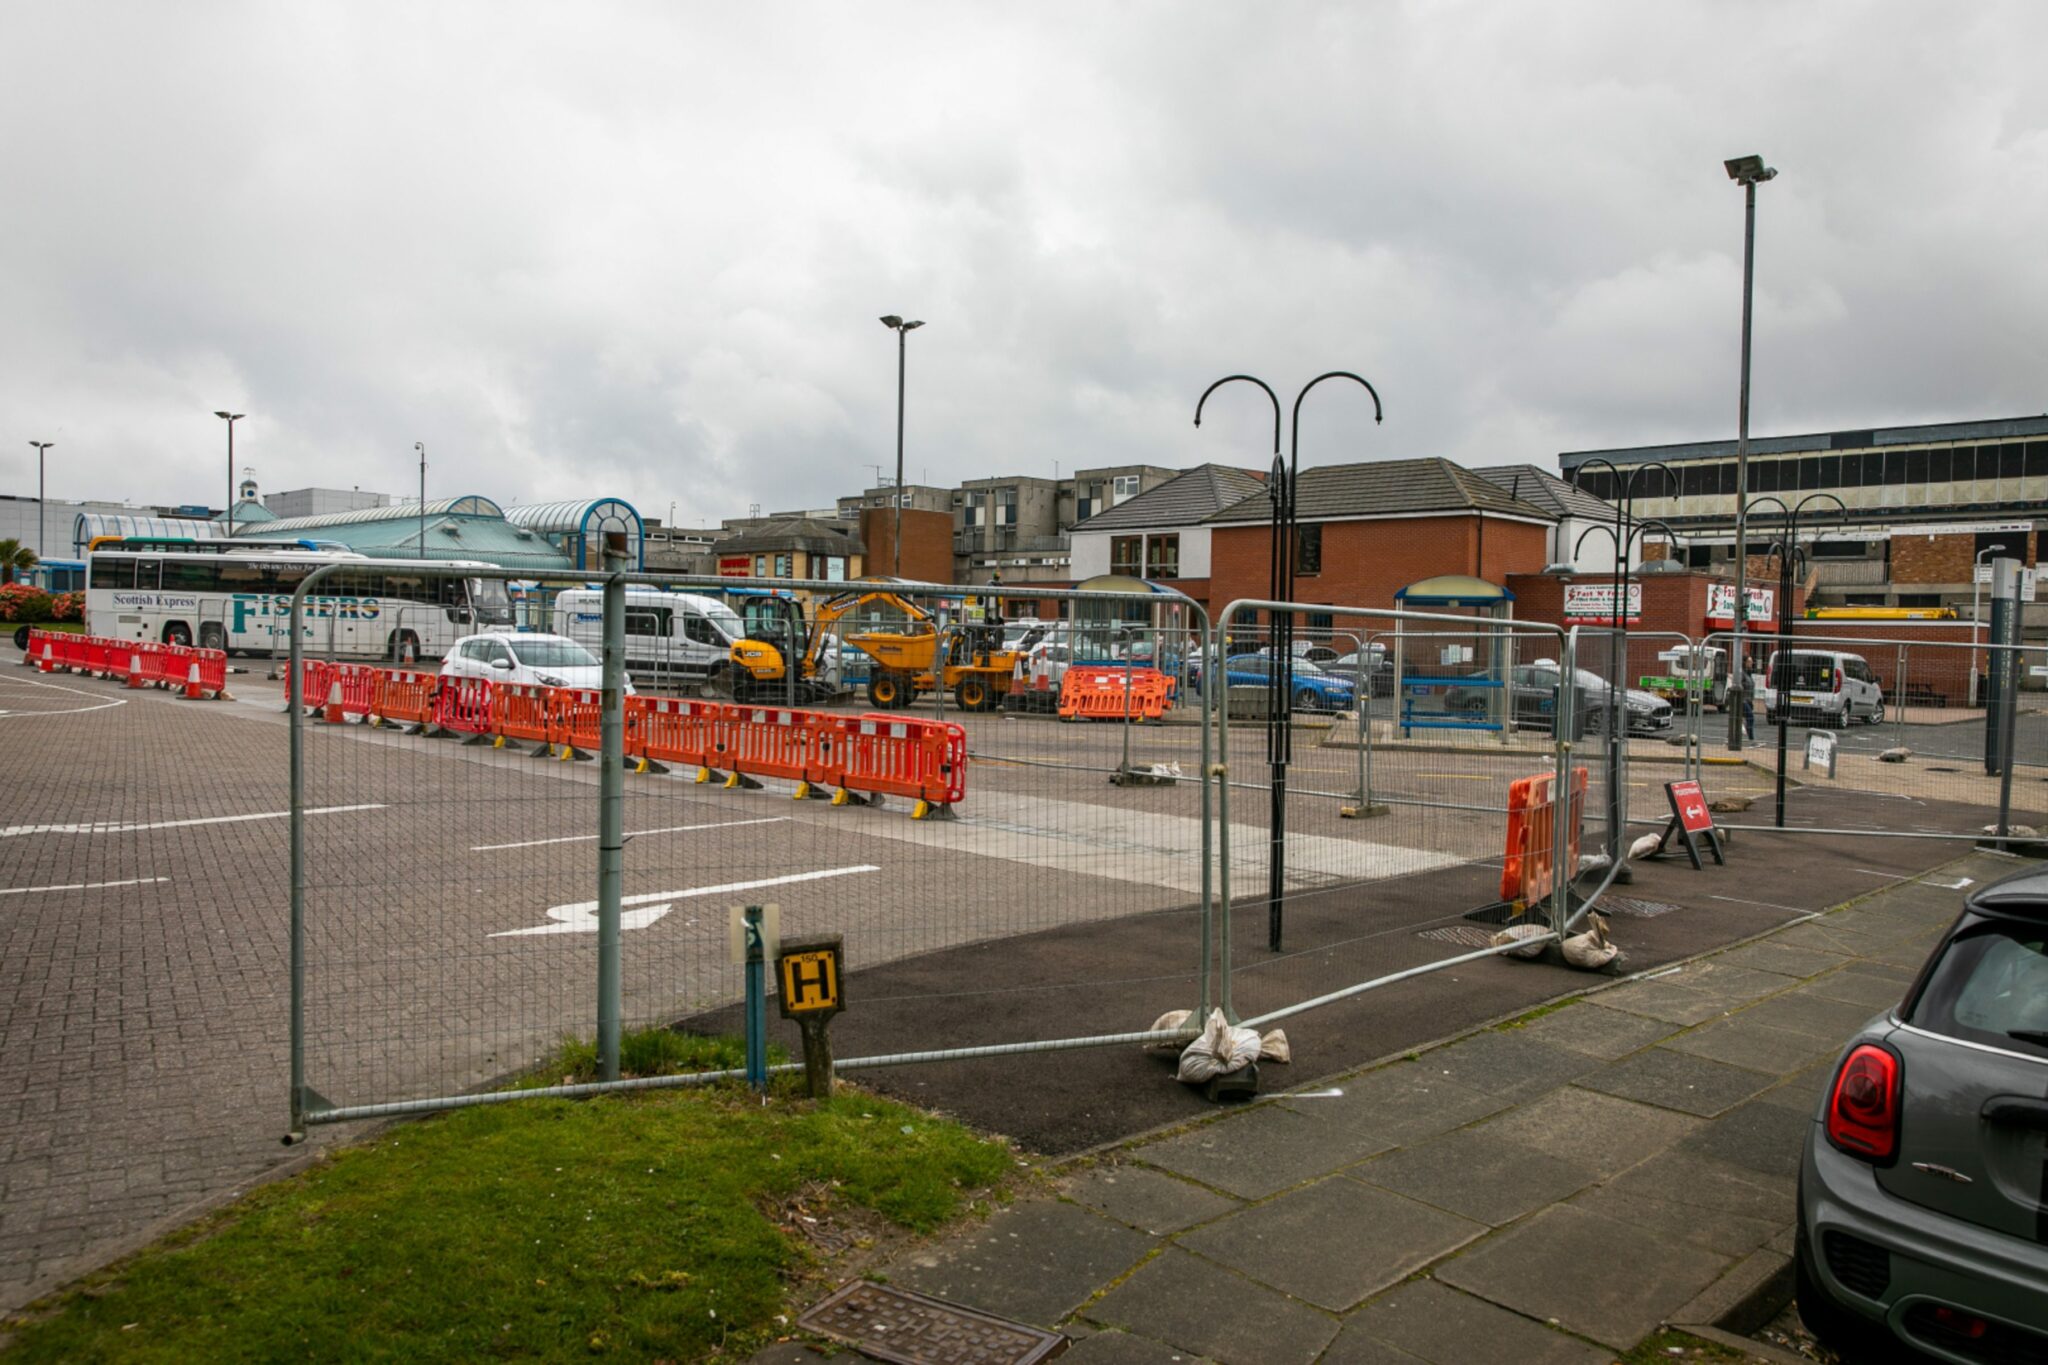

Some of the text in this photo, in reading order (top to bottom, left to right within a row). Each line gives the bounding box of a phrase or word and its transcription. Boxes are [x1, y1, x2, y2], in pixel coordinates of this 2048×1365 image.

[113, 594, 195, 609] Scottish Express
[800, 953, 819, 962] 150
[791, 958, 831, 1003] H
